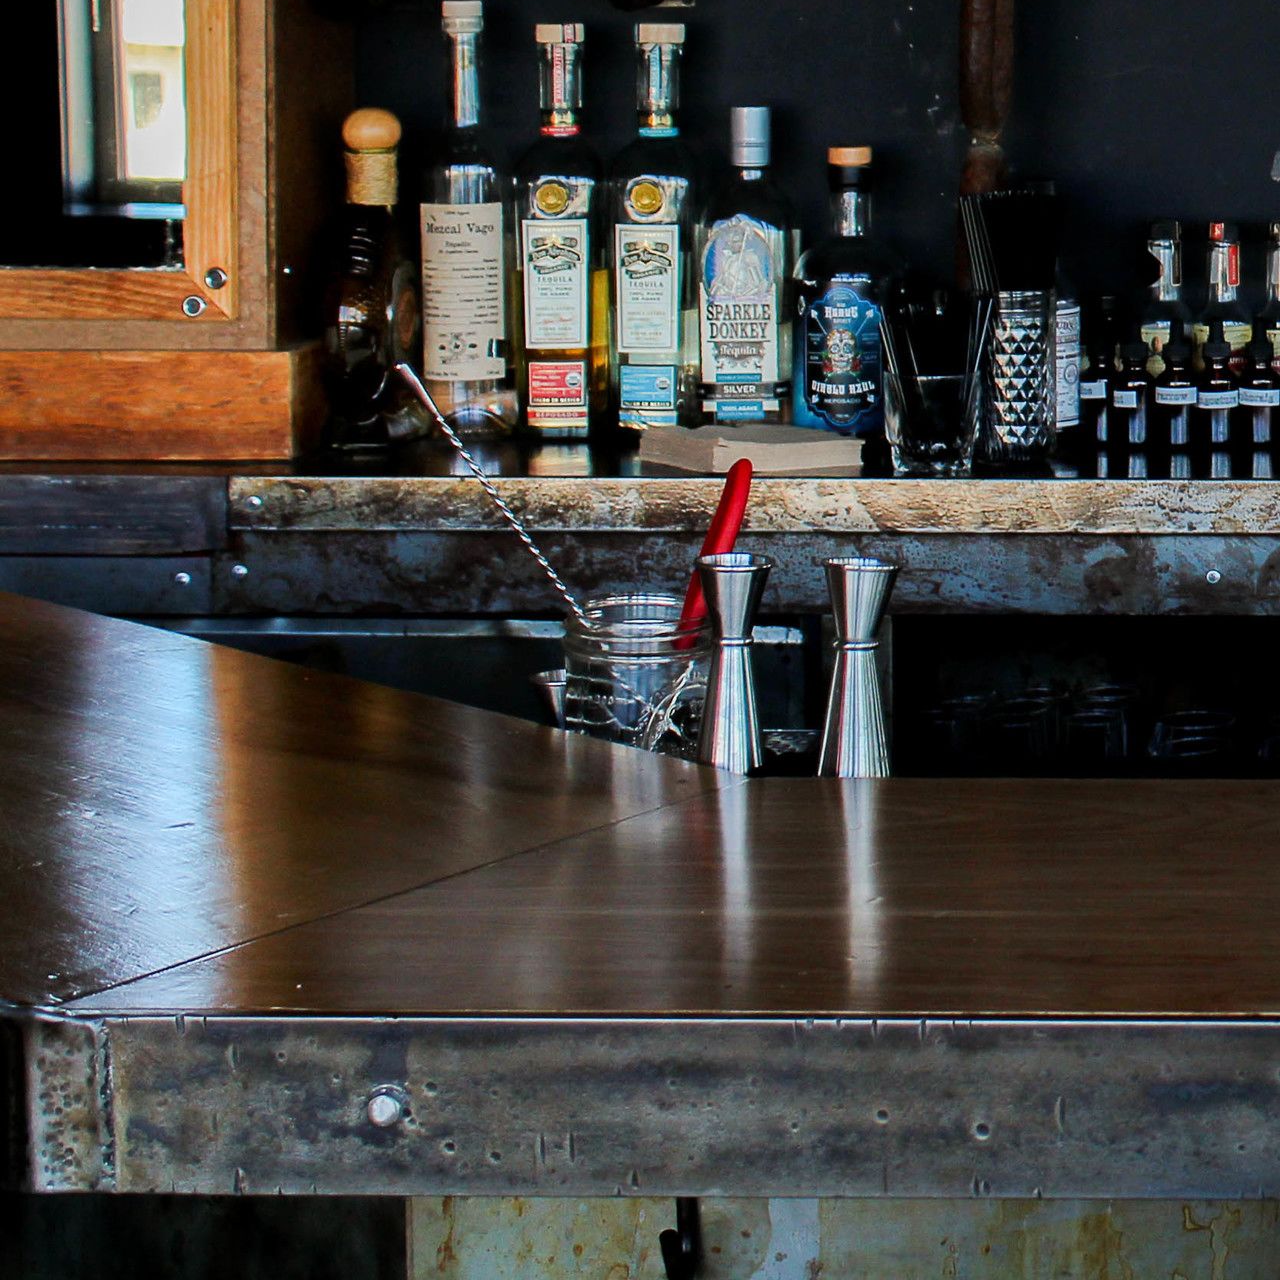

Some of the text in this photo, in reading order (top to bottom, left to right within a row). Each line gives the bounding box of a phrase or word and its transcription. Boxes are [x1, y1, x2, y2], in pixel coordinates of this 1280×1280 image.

[426, 221, 495, 235] Mezcal Vago
[706, 304, 771, 321] SPARKLE
[710, 322, 768, 339] DONKEY
[720, 344, 757, 358] Tequila
[723, 385, 756, 394] SILVER
